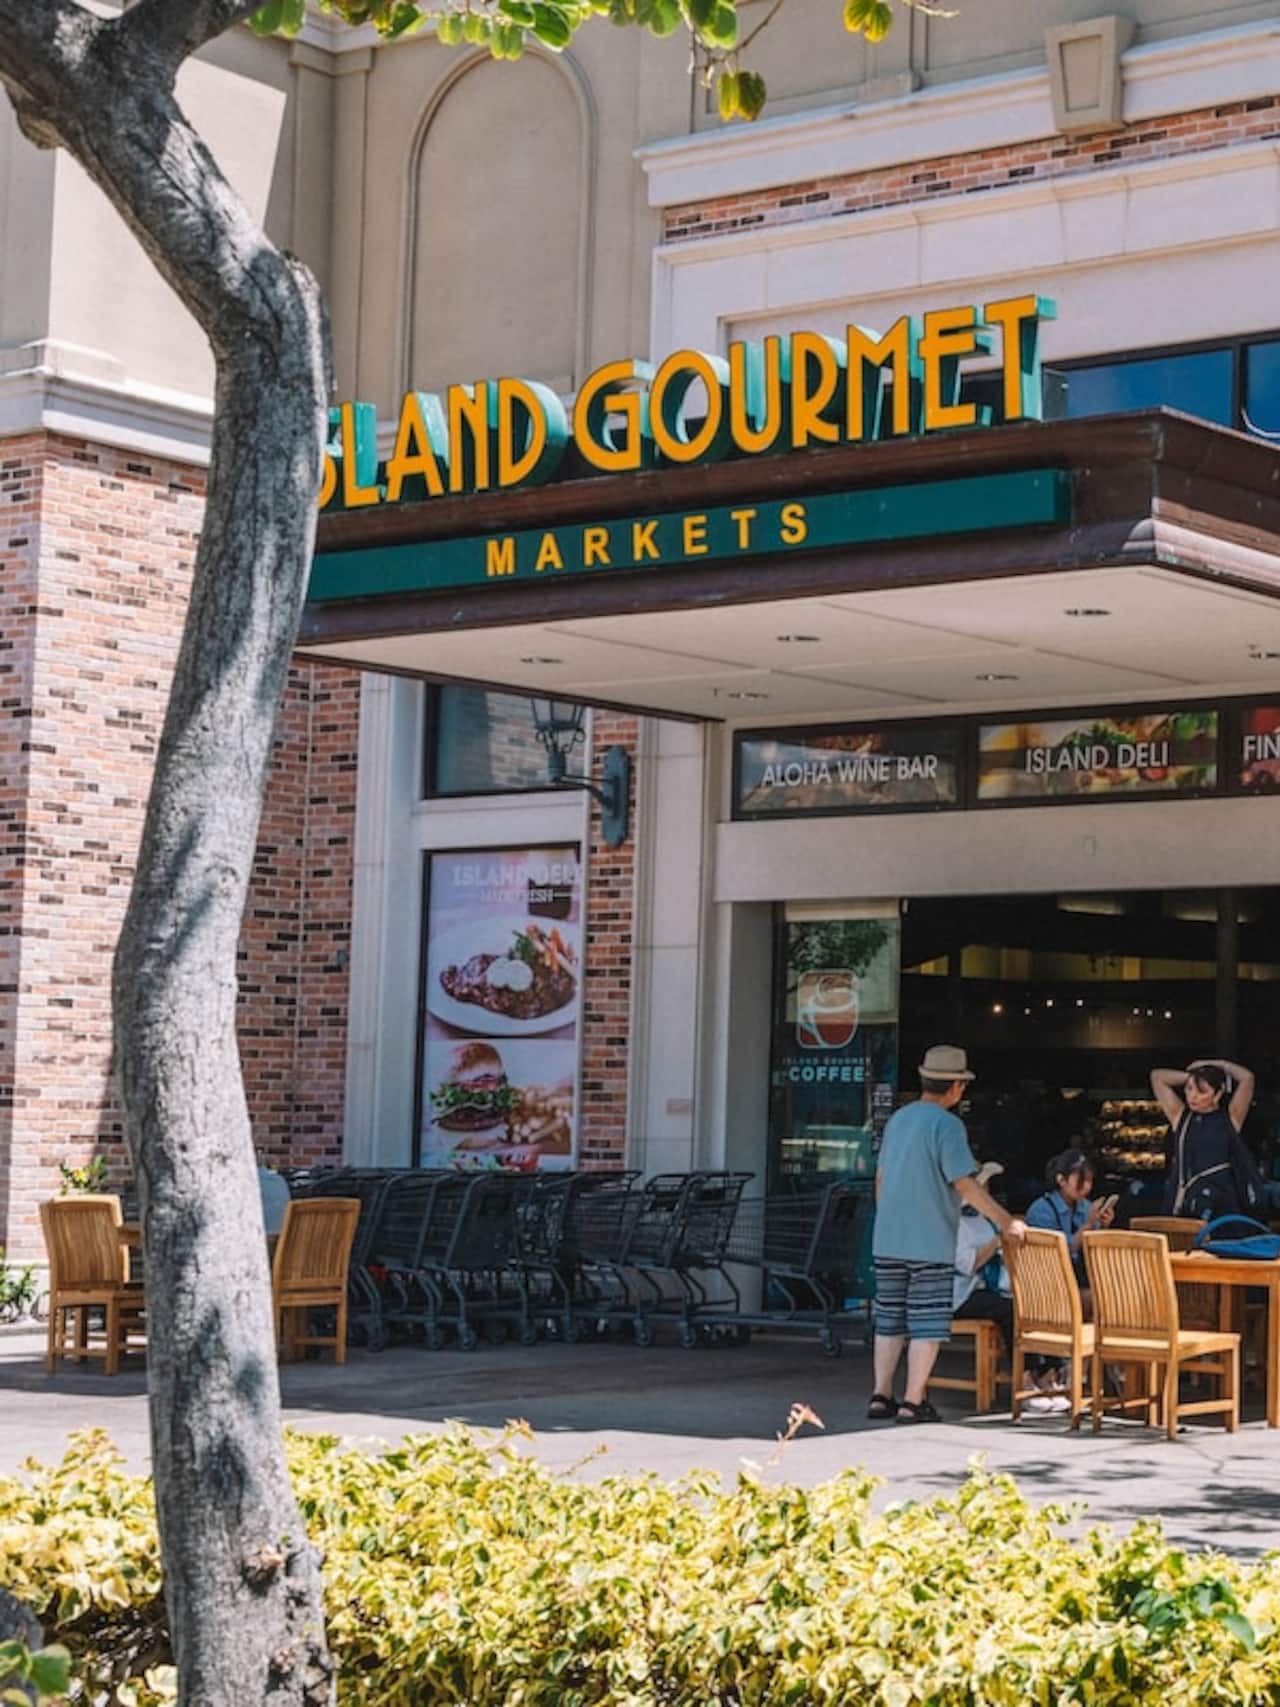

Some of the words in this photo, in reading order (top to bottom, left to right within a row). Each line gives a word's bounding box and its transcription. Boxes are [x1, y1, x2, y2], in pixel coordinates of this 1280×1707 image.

[319, 378, 547, 509] LAND
[573, 295, 1038, 471] GOURMET
[486, 504, 808, 576] MARKETS
[761, 762, 831, 787] ALOHA
[837, 757, 890, 784] WINE
[897, 754, 938, 780] BAR
[1025, 745, 1110, 773] ISLAND
[1117, 741, 1169, 768] DELI
[788, 1066, 865, 1082] COFFEE
